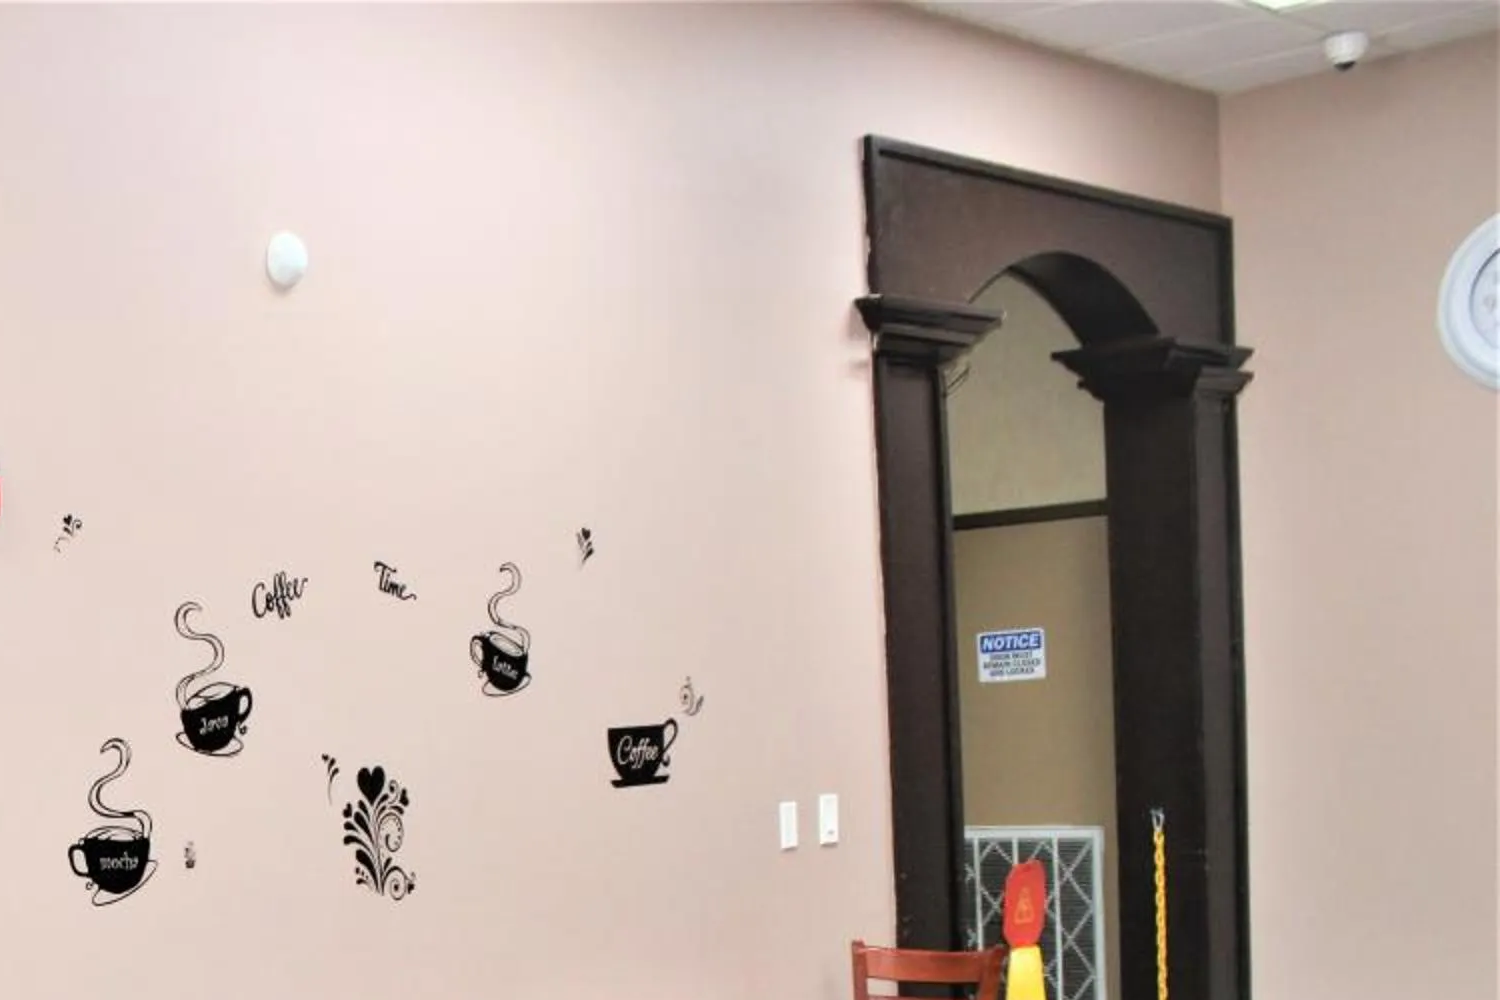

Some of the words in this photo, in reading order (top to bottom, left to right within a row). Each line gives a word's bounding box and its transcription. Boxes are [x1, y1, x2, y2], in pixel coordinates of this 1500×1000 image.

[252, 571, 308, 619] Coffee
[374, 561, 417, 600] Time
[982, 633, 1040, 651] NOTICE
[617, 735, 659, 769] Coffee
